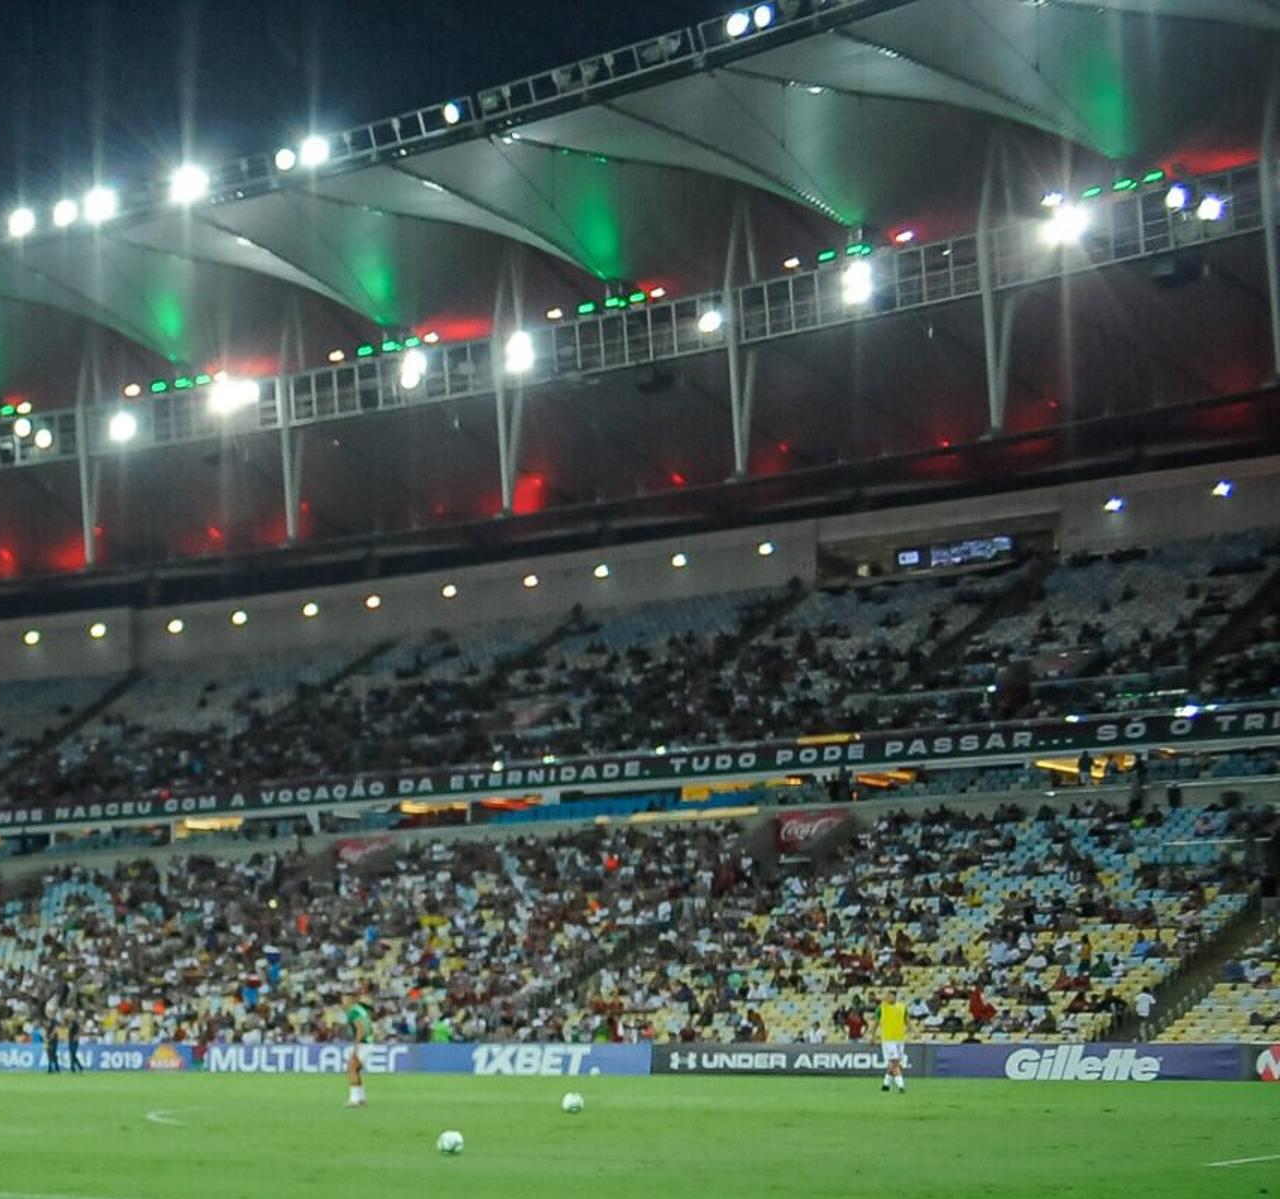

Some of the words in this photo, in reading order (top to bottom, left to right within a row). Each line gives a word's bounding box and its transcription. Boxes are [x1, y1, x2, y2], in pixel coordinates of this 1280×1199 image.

[55, 801, 152, 820] NASCEU
[164, 795, 217, 813] COM
[230, 793, 245, 807] A
[397, 777, 433, 793] DA
[670, 752, 757, 773] TUDO
[775, 742, 866, 765] PODE
[885, 731, 1073, 757] PASSAR...
[1169, 718, 1192, 735] O
[99, 1051, 143, 1070] 2019
[701, 1052, 786, 1069] UNDER
[1005, 1045, 1160, 1080] Gillette
